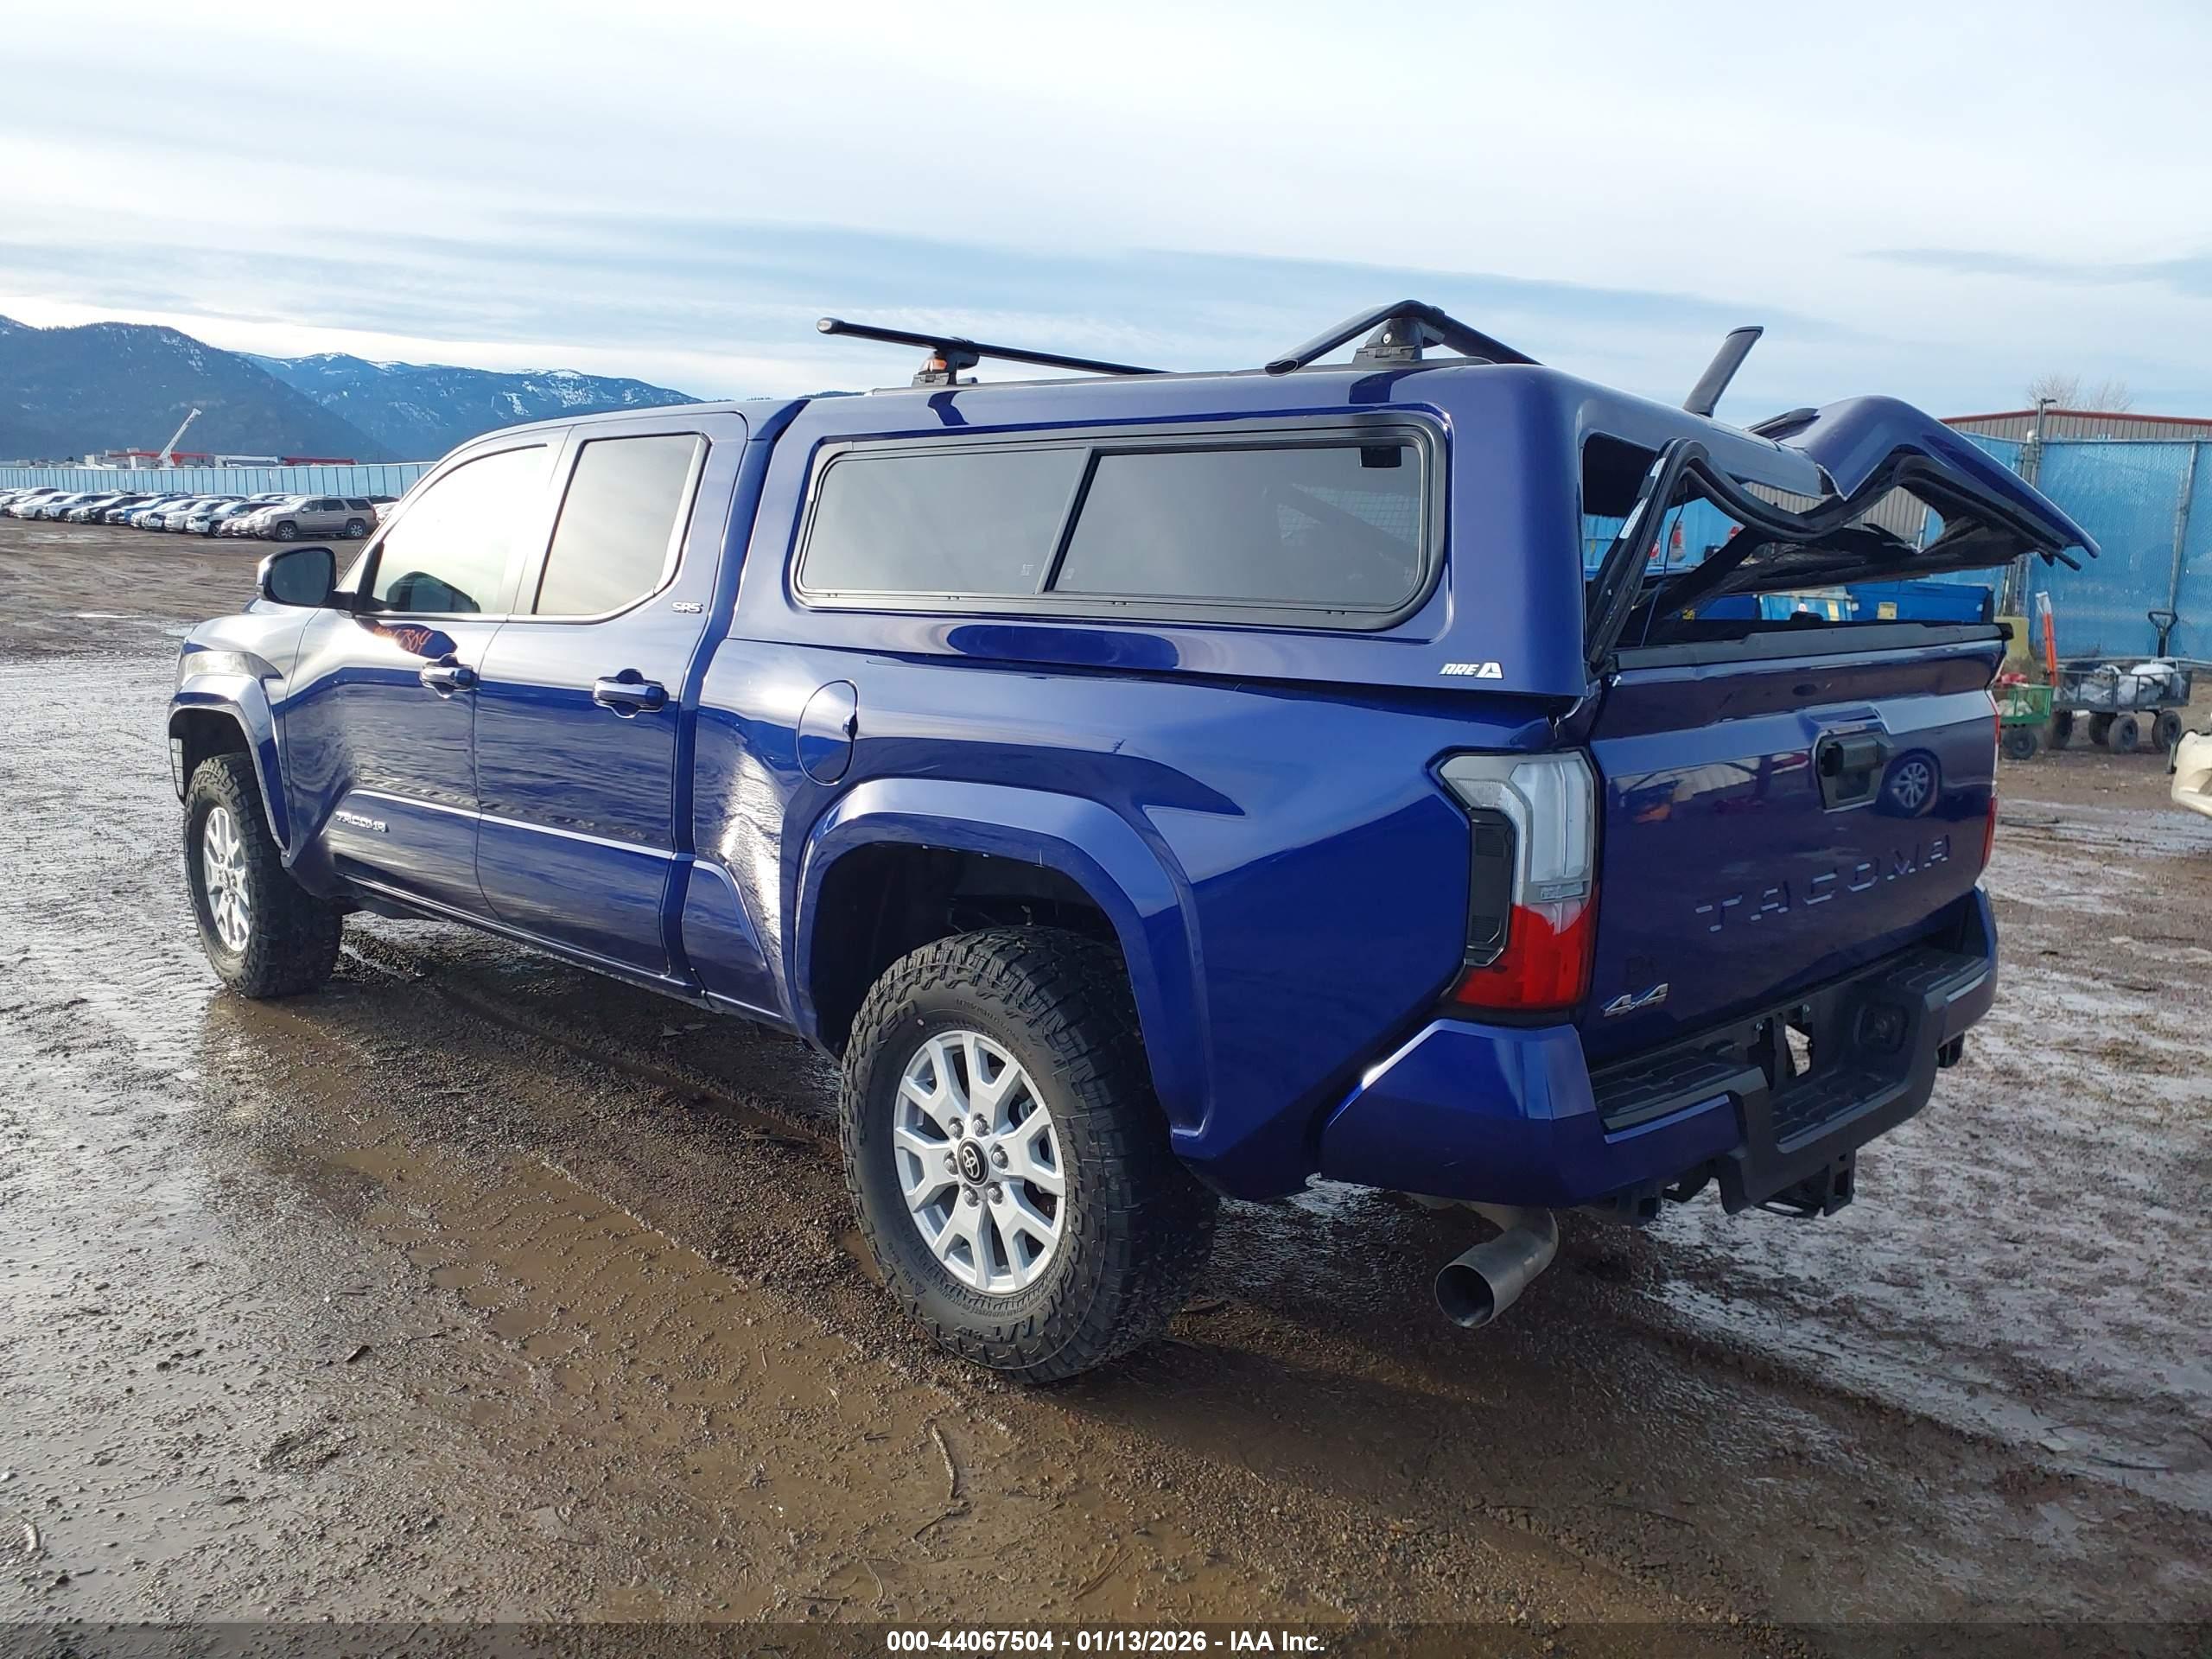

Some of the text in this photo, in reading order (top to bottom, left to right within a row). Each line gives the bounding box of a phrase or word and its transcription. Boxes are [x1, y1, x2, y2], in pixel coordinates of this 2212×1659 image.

[671, 601, 702, 613] SR5
[335, 810, 388, 833] TACOMA
[1695, 835, 1951, 931] TACOMA
